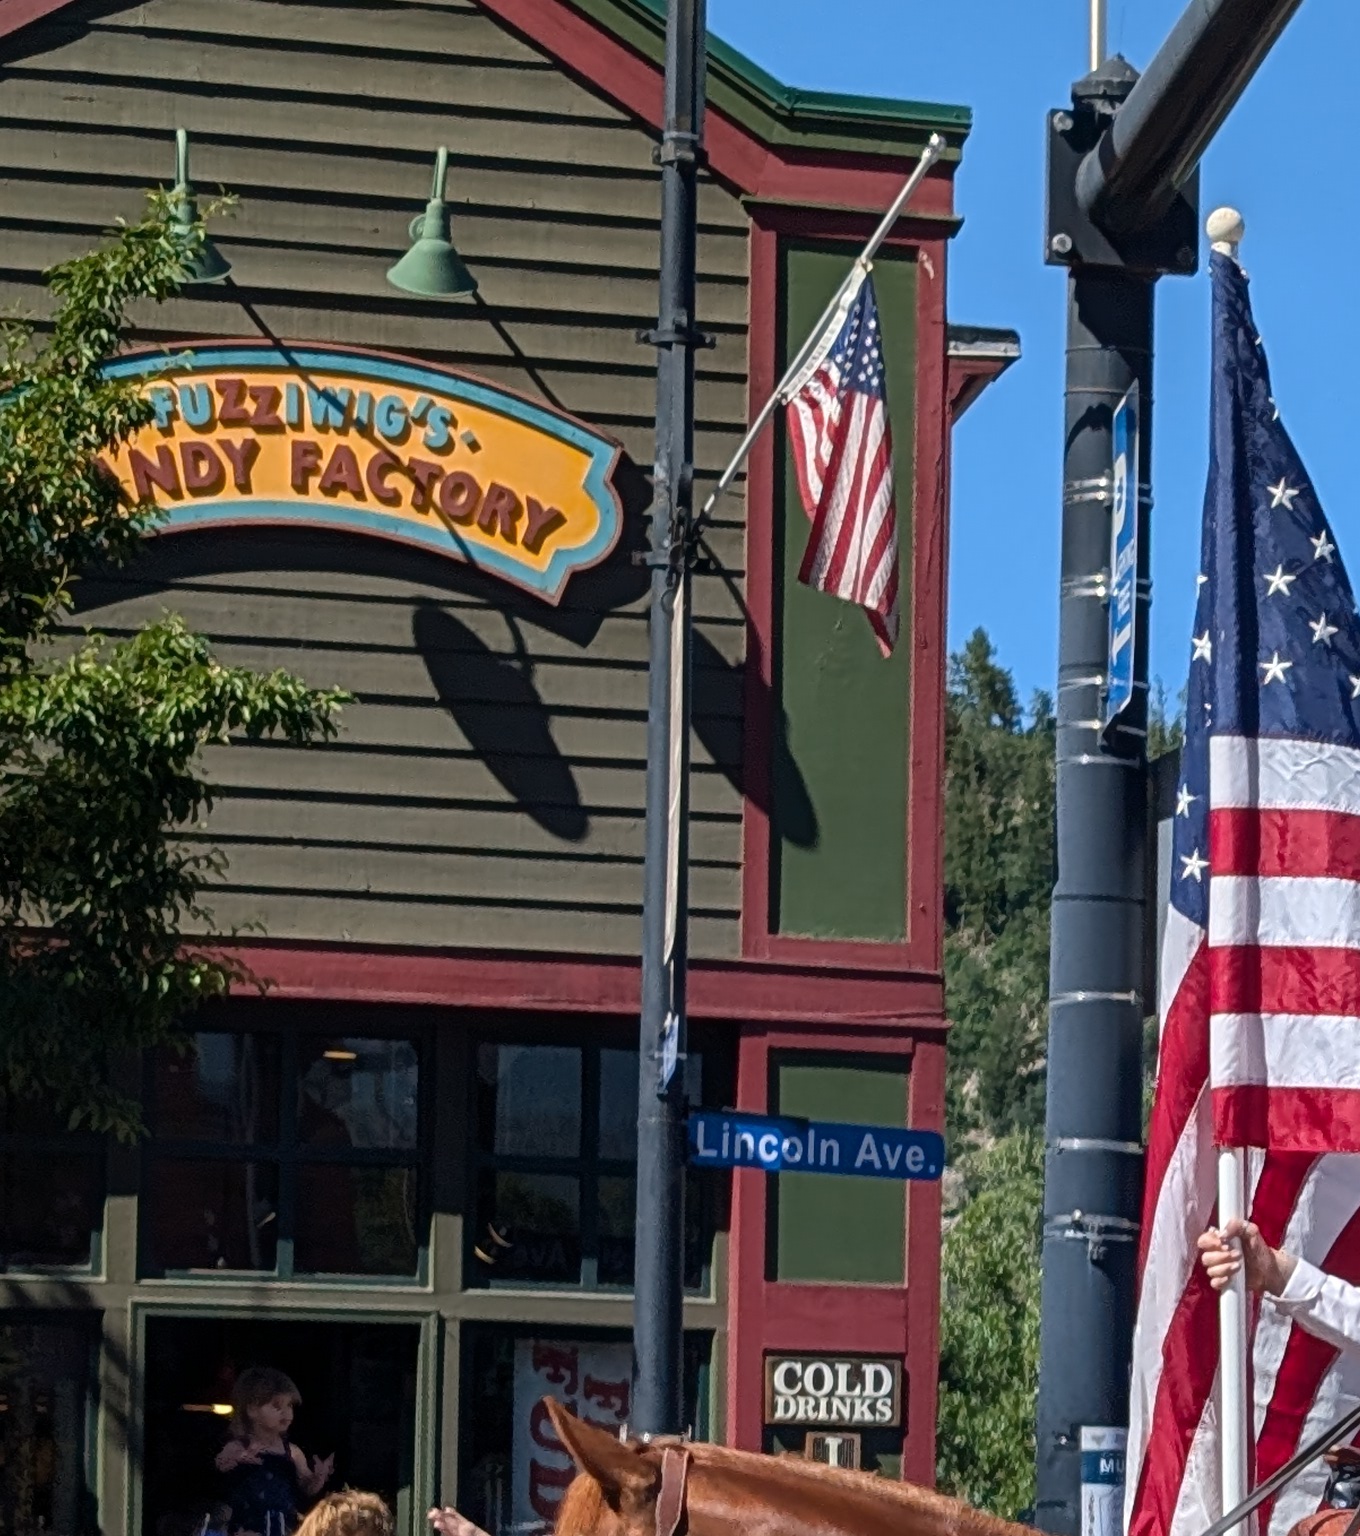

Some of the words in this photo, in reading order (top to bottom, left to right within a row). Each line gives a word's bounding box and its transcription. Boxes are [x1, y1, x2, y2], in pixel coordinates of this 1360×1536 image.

[149, 378, 456, 454] FUZZIWIG'S
[291, 440, 567, 555] FACTORY
[696, 1120, 840, 1167] Lincoln
[854, 1132, 936, 1174] Ave.
[773, 1361, 893, 1398] COLD
[773, 1396, 893, 1423] DRINKS
